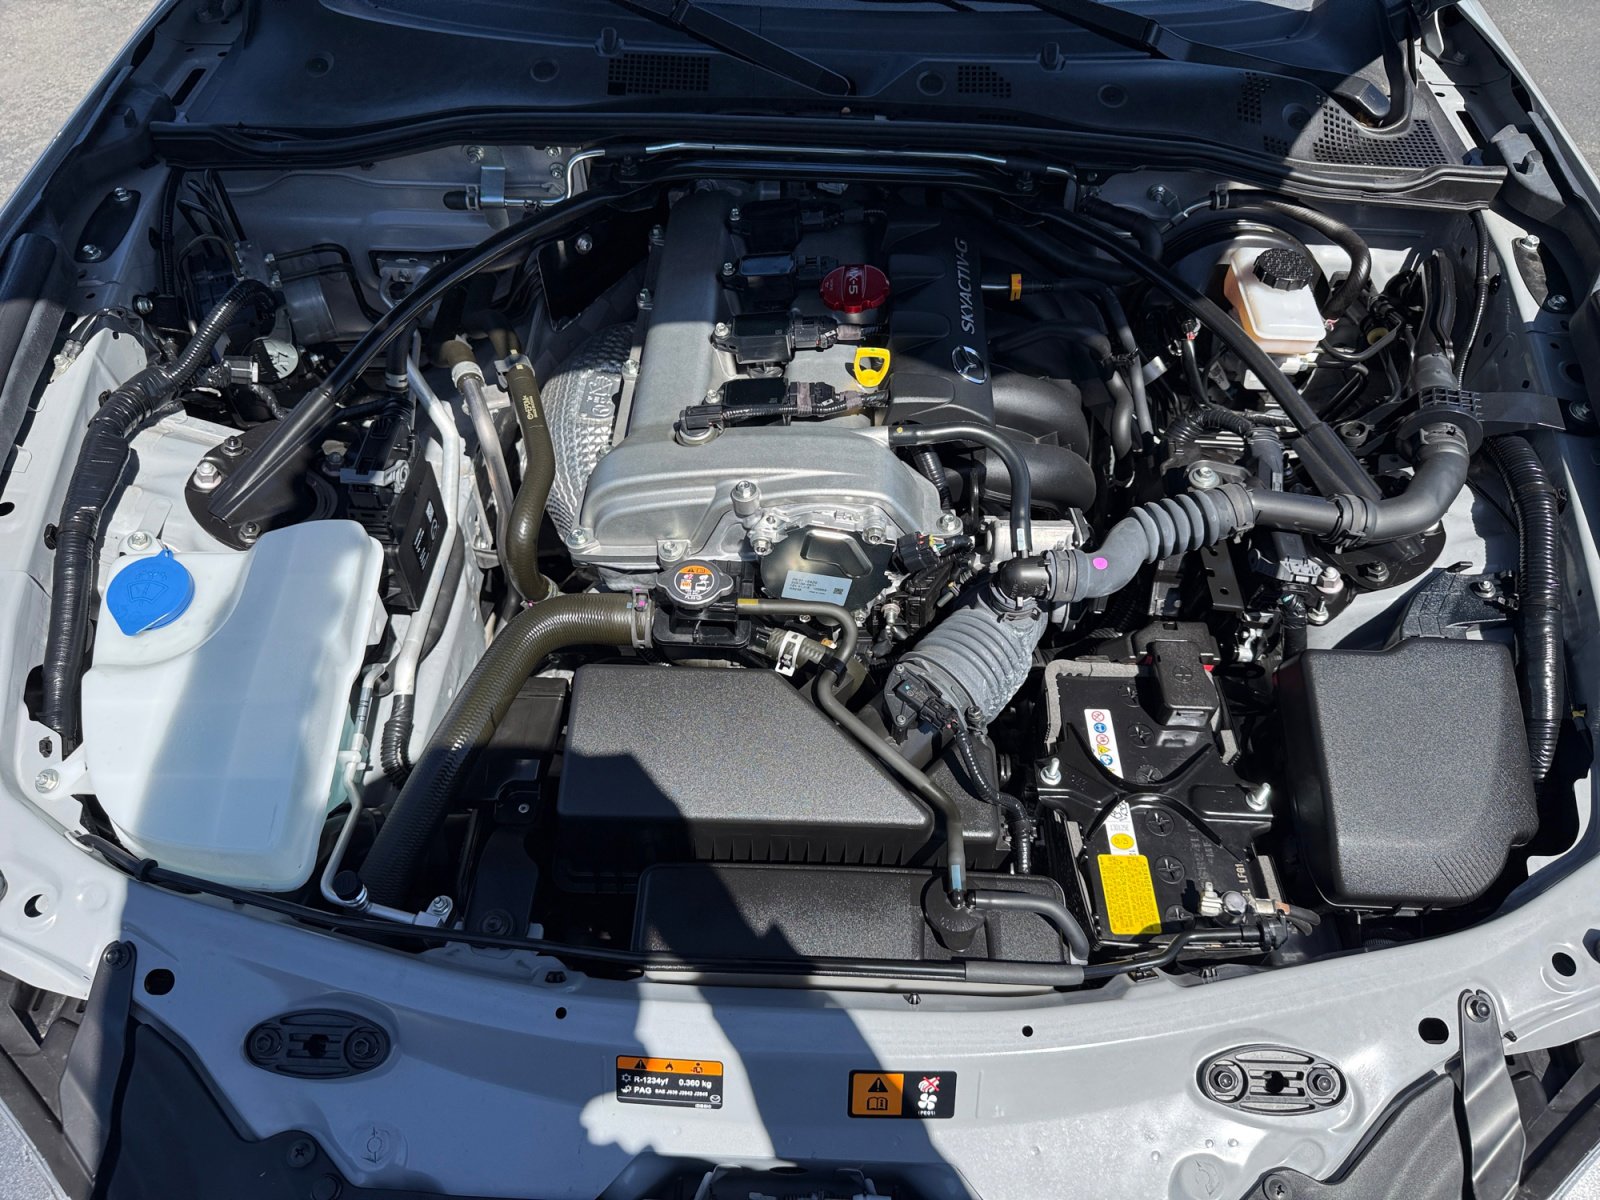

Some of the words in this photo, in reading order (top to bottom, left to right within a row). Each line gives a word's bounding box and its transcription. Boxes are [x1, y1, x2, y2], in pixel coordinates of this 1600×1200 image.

[848, 267, 859, 295] MX-5
[954, 237, 975, 335] SKYACTIV-G
[633, 1076, 669, 1086] R-1234yf
[678, 1078, 700, 1087] 0.360
[701, 1080, 712, 1089] kg
[633, 1086, 652, 1095] PAG
